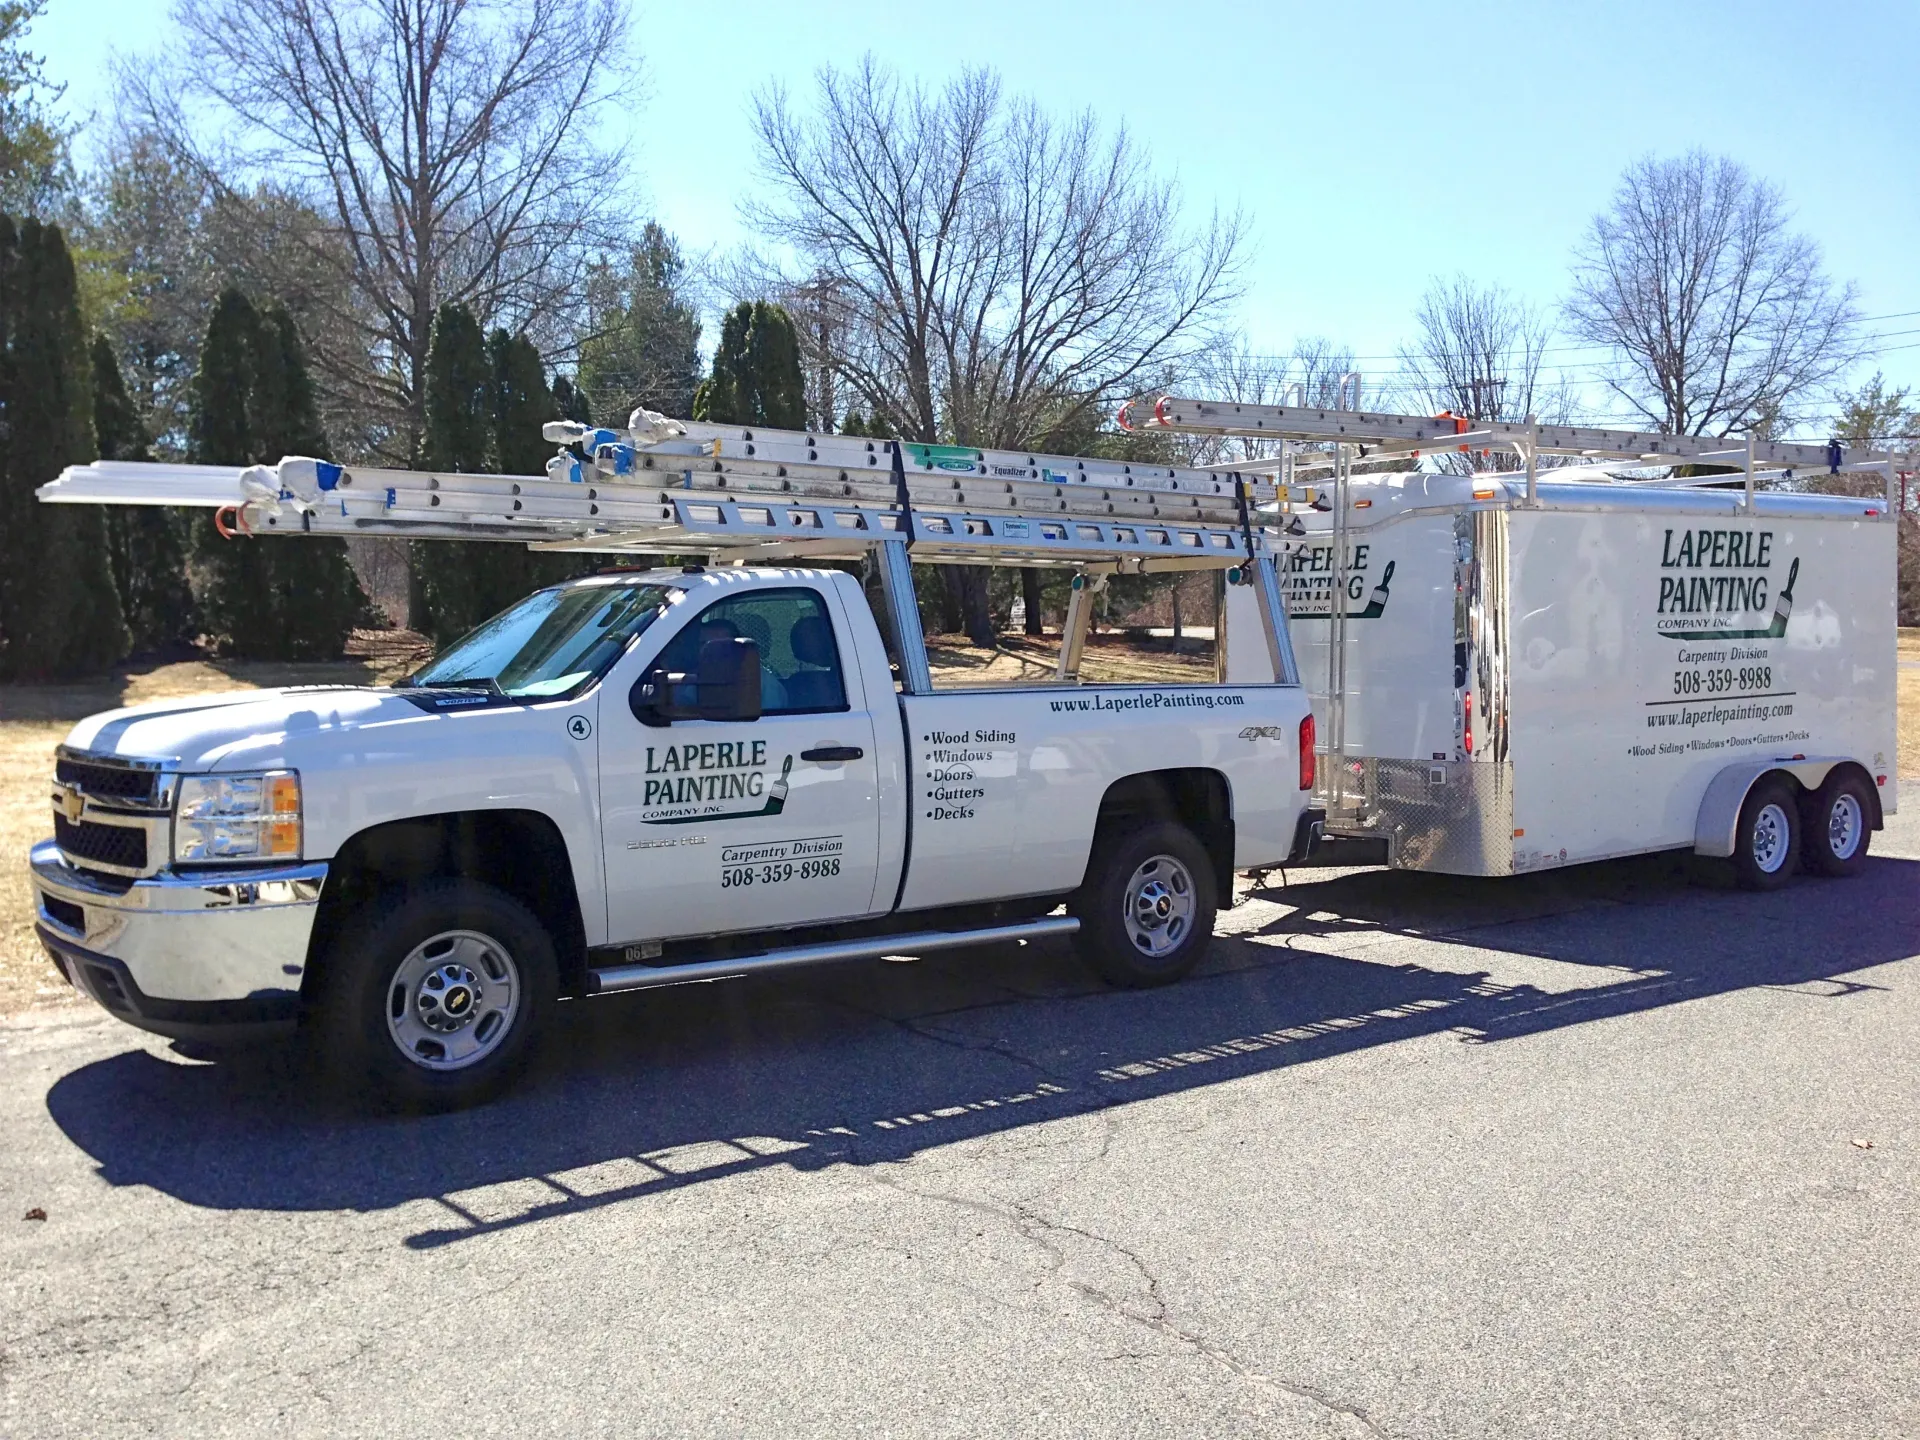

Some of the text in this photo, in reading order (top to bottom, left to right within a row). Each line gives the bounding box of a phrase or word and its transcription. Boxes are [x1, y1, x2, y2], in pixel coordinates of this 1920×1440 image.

[994, 467, 1027, 477] Equalizer
[1661, 529, 1773, 568] LAPERLE
[1657, 576, 1768, 614] PAINTING
[1657, 618, 1710, 629] COMPANY
[1678, 647, 1768, 665] Carpentry Division
[1673, 666, 1772, 695] 508-359-8988
[1050, 693, 1244, 713] www.LaperlePainting.com
[1647, 703, 1793, 728] www.laperlepainting.com
[572, 720, 585, 734] 4
[931, 729, 1016, 745] Wood Siding
[1632, 730, 1810, 757] Wood Siding Windows Doors Gutters Decks
[645, 740, 767, 774] LAPERLE
[933, 749, 993, 763] Windows
[933, 768, 974, 782] Doors
[643, 771, 764, 806] PAINTING
[934, 787, 985, 801] Gutters
[642, 807, 700, 819] COMPANY
[933, 805, 975, 820] Decks
[721, 841, 843, 862] Carpentry Division
[721, 858, 841, 888] 508-359-8988
